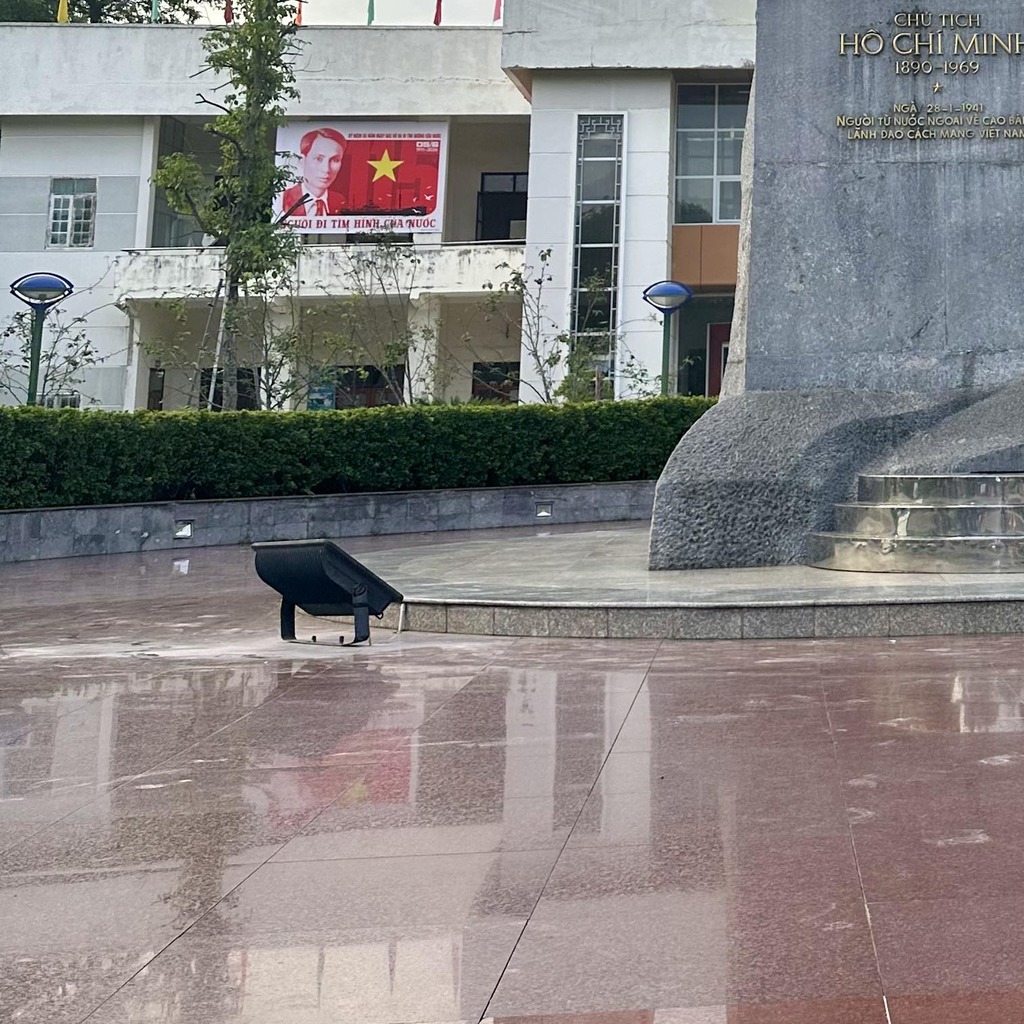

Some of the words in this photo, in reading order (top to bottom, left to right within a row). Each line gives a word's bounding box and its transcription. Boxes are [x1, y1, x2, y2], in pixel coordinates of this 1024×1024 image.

[939, 13, 981, 31] TỊCH
[892, 30, 943, 55] CHÍ
[982, 116, 1006, 126] CAO
